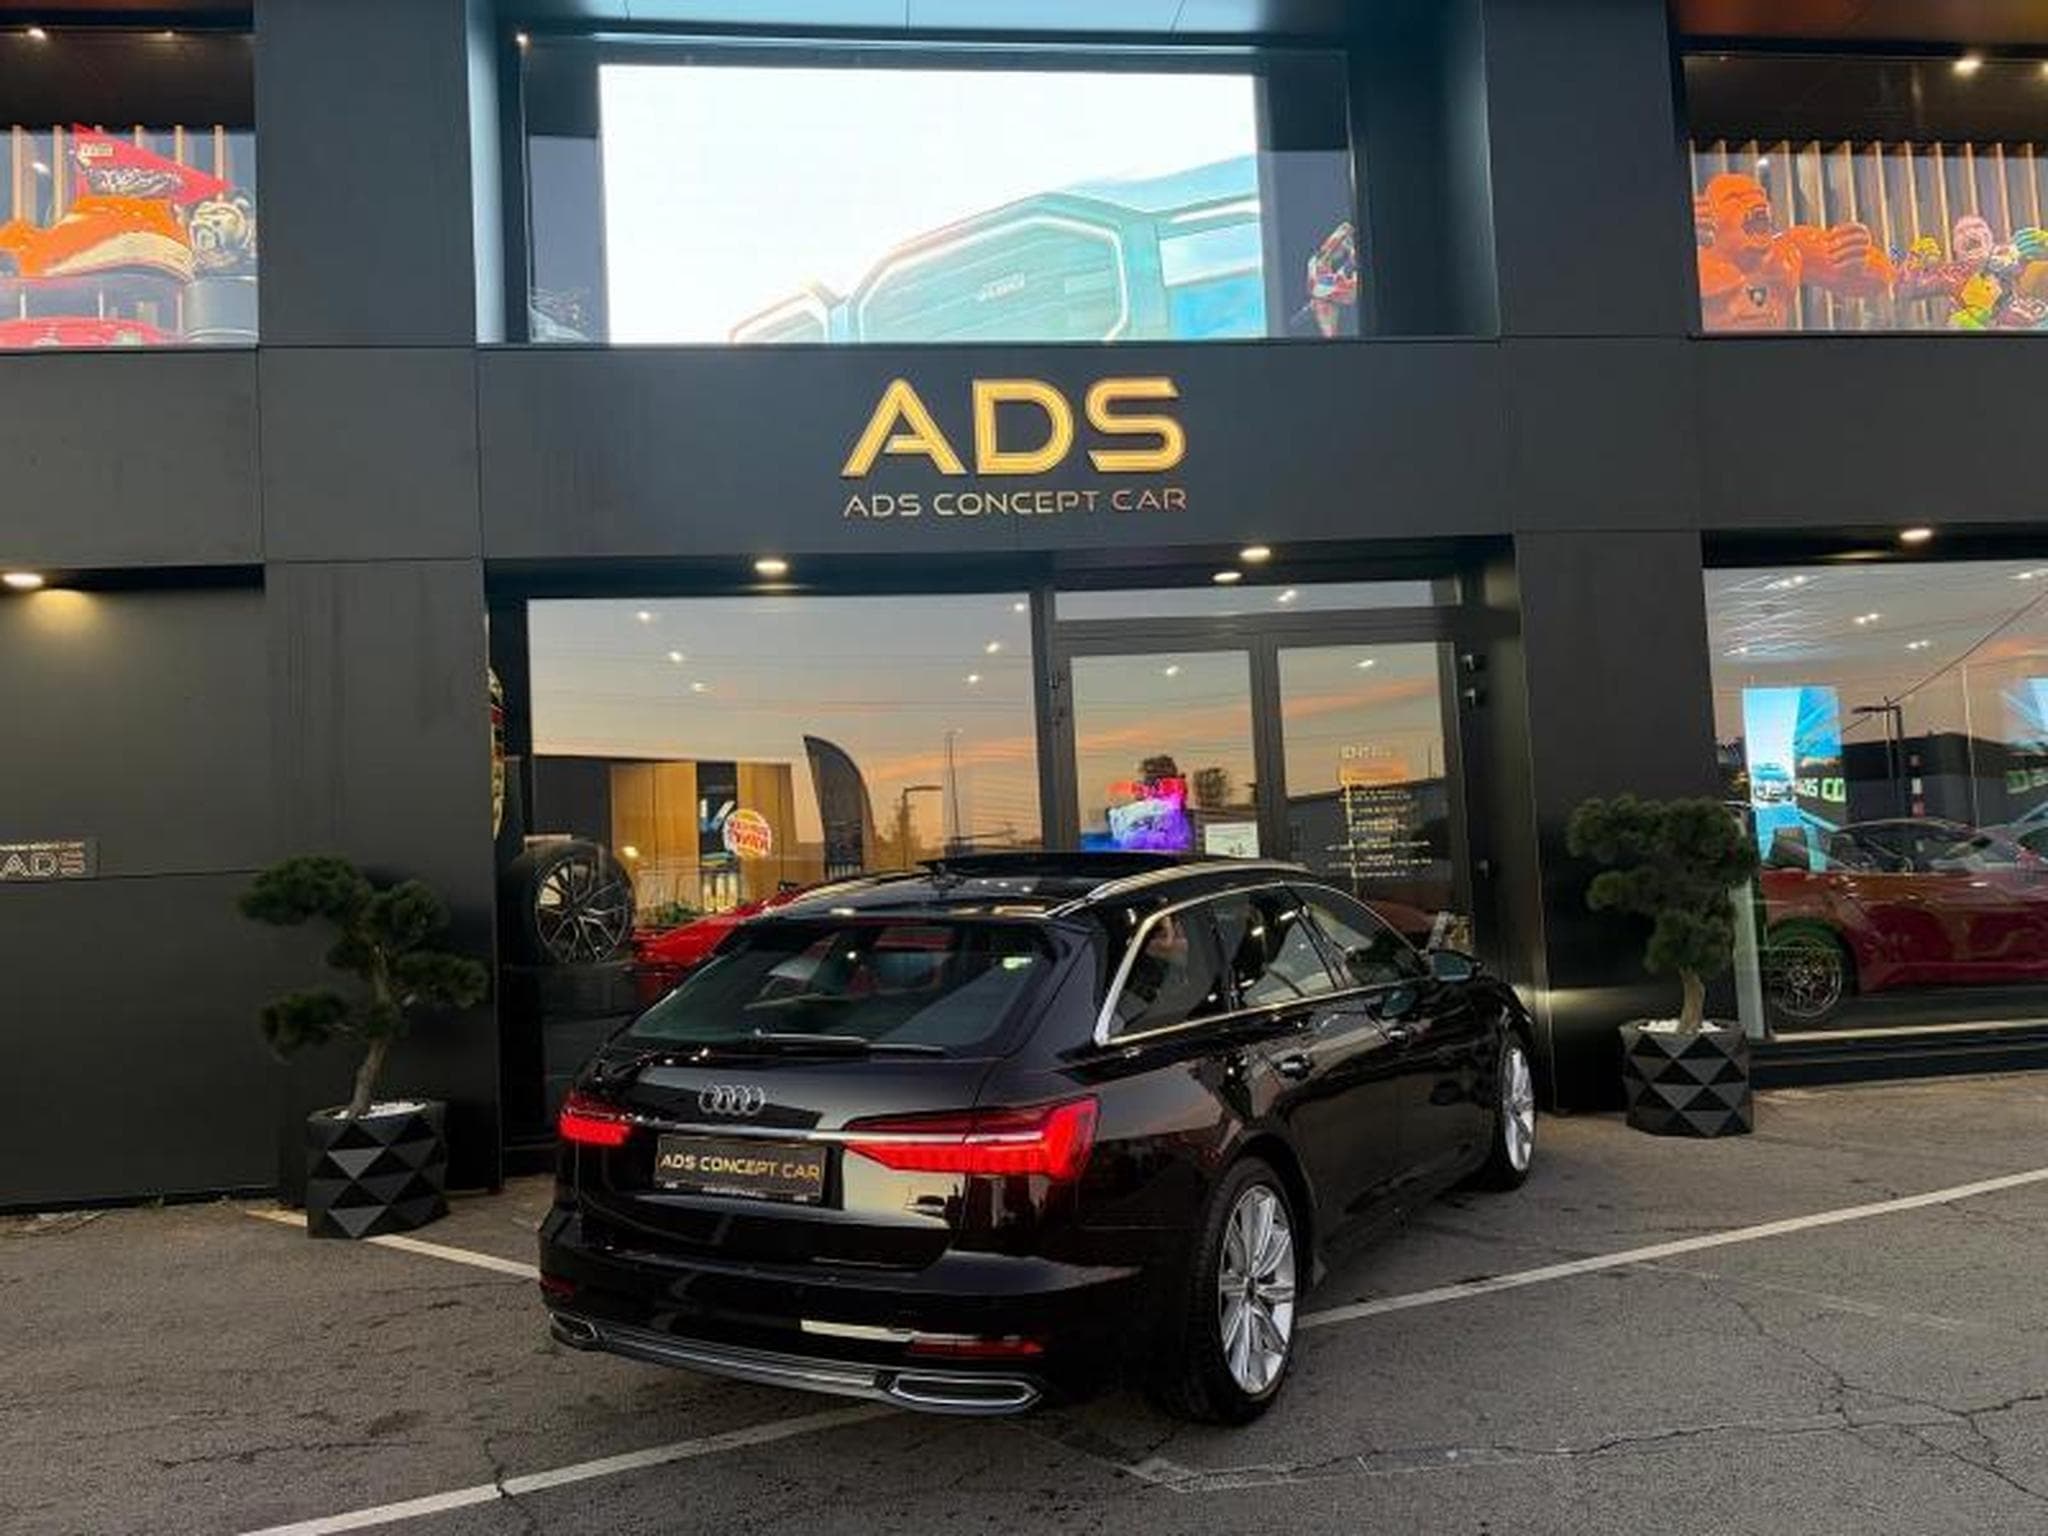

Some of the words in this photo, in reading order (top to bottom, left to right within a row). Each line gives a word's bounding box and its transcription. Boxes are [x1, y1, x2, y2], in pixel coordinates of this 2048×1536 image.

[840, 377, 1186, 477] ADS
[843, 493, 921, 518] ADS
[933, 490, 1100, 516] CONCEPT
[1111, 487, 1187, 512] CAR
[660, 1154, 697, 1171] ADS
[699, 1156, 779, 1177] CONCEPT
[782, 1163, 821, 1181] CAR
